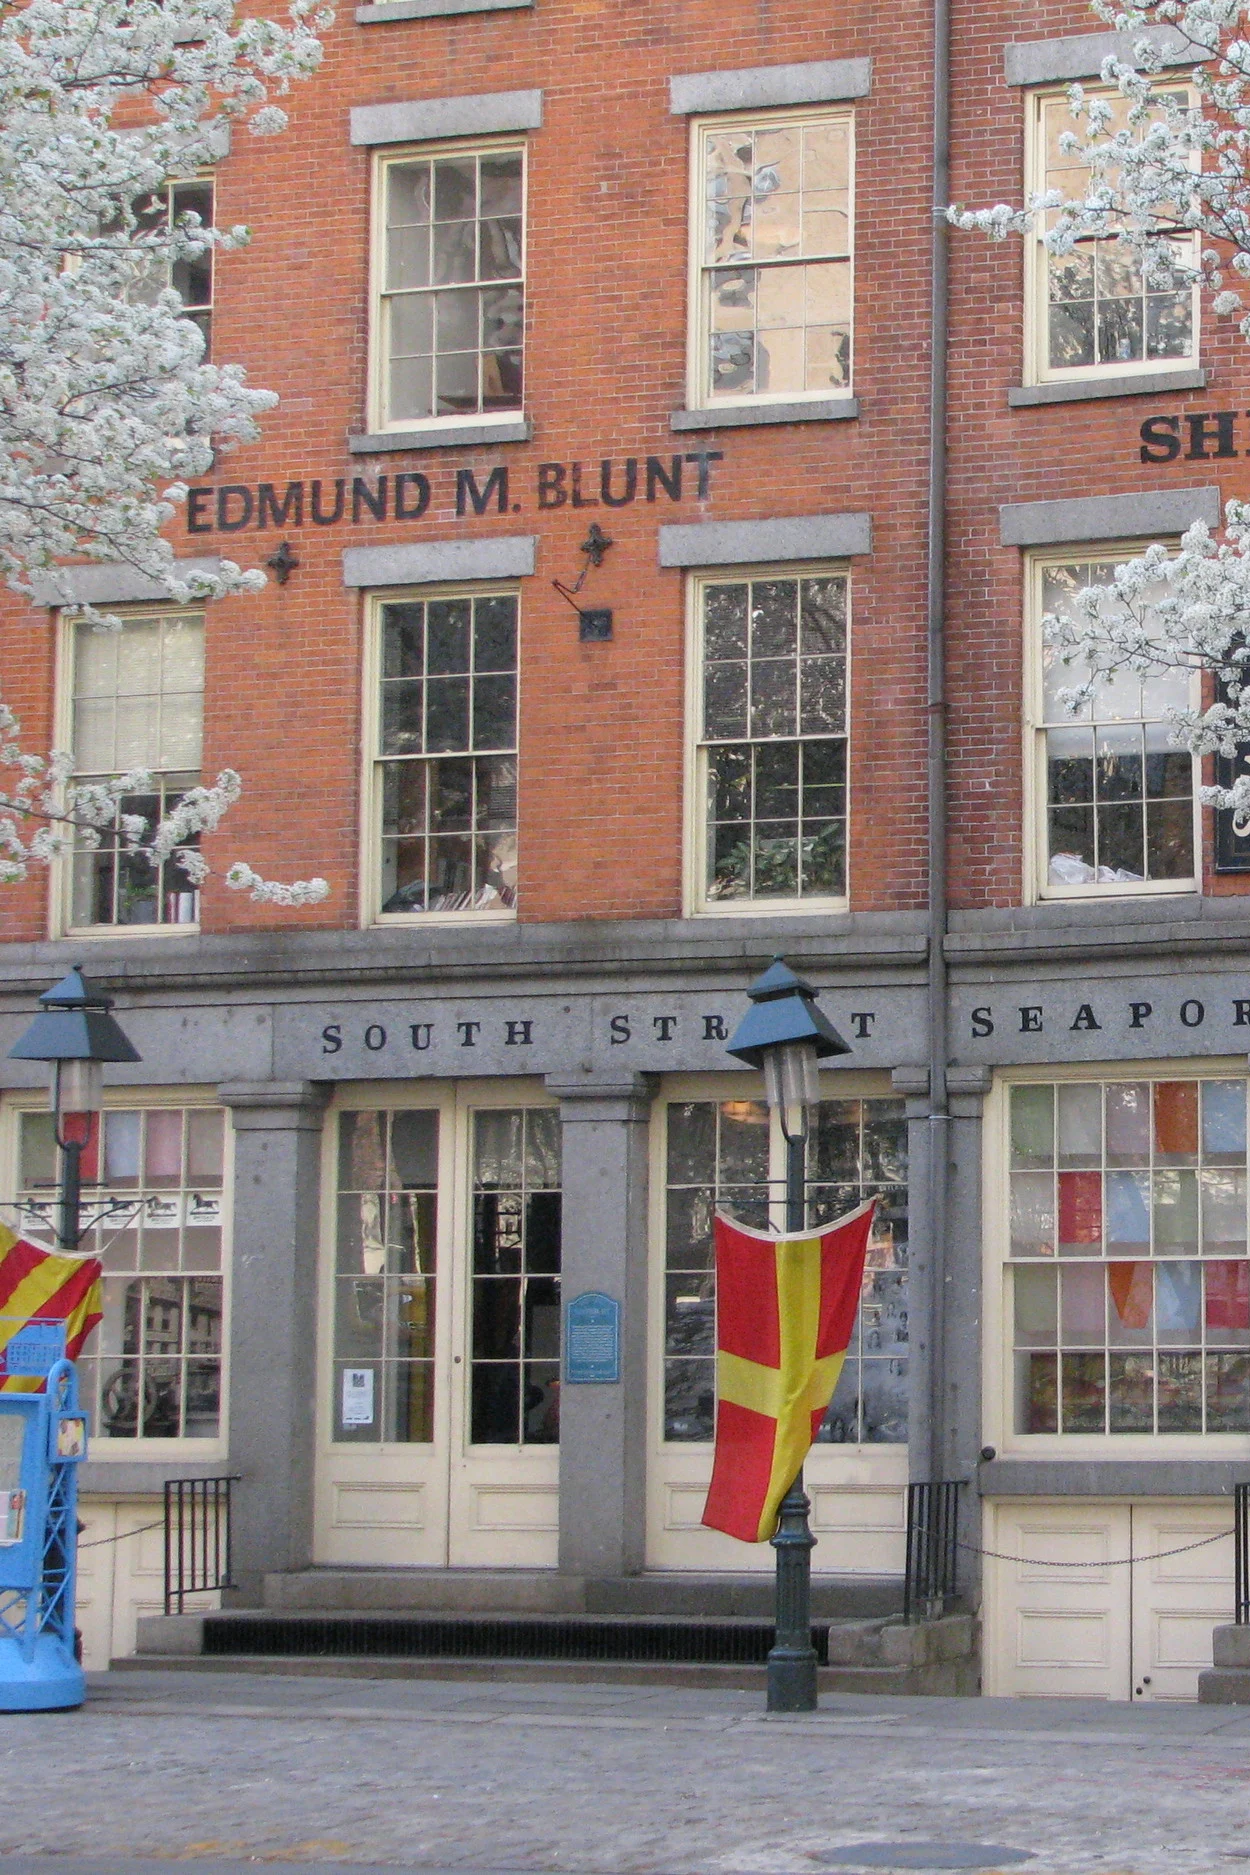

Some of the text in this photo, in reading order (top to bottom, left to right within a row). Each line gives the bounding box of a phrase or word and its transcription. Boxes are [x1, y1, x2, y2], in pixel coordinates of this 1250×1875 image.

[186, 450, 724, 533] EDMUND M. BLUNT
[321, 1018, 534, 1054] SOUTH
[610, 1011, 875, 1045] STRT
